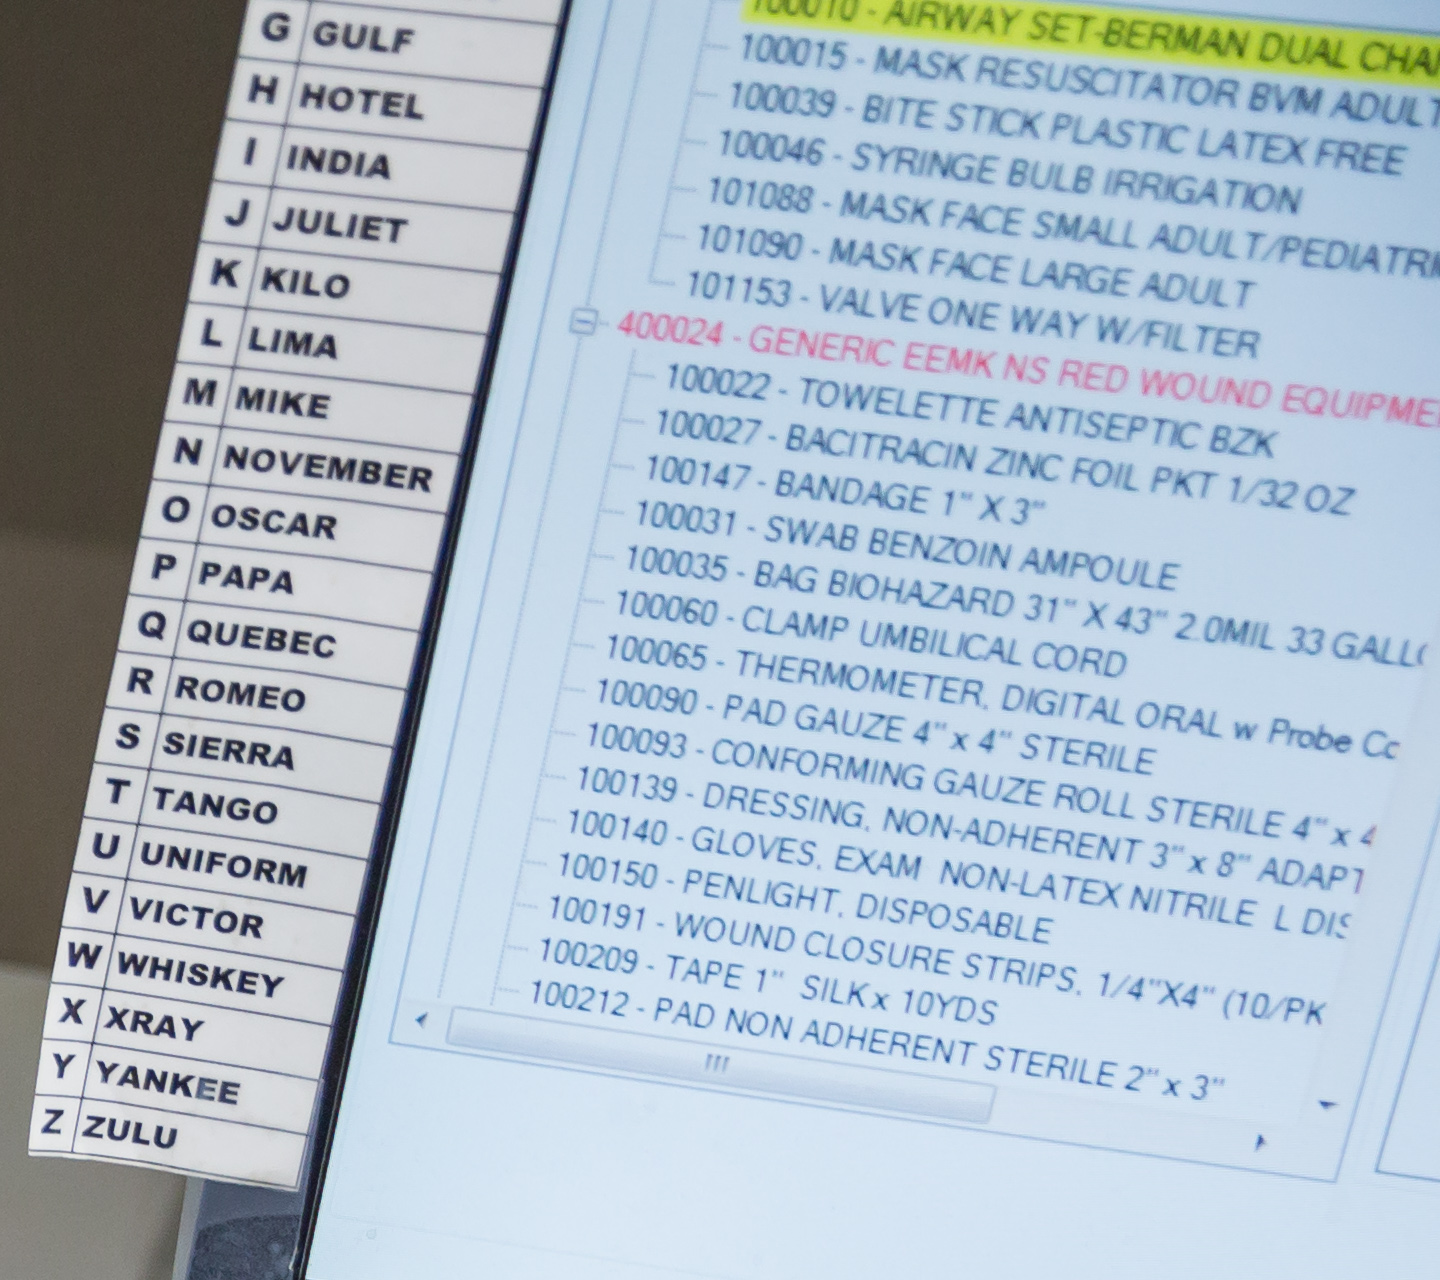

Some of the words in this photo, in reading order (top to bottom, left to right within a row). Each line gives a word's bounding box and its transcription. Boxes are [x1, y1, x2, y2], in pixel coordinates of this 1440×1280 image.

[260, 11, 291, 43] G
[312, 20, 415, 54] GULF
[883, 0, 1020, 37] AIRWAY
[1027, 12, 1249, 60] SET-BERMAN
[1259, 31, 1349, 70] DUAL
[247, 73, 279, 105] H
[298, 82, 424, 121] HOTEL
[741, 31, 849, 72] 100015
[872, 44, 971, 83] MASK
[973, 53, 1242, 109] RESUSCITATOR
[1245, 79, 1326, 117] BVM
[730, 79, 838, 119] 100039
[860, 91, 939, 130] BITE
[943, 100, 1046, 140] STICK
[1048, 111, 1191, 156] PLASTIC
[1195, 127, 1310, 167] LATEX
[1312, 136, 1410, 178] FREE
[243, 136, 257, 166] I
[286, 144, 390, 180] INDIA
[719, 128, 827, 167] 100046
[849, 140, 1001, 186] SYRINGE
[1004, 156, 1095, 196] BULB
[1101, 167, 1304, 216] IRRIGATION
[223, 198, 250, 227] J
[271, 206, 409, 243] JULIET
[209, 257, 241, 288] K
[259, 266, 350, 299] KILO
[698, 222, 805, 262] 101090
[826, 236, 924, 275] MASK
[927, 246, 1014, 285] FACE
[1017, 256, 1135, 298] LARGE
[1136, 270, 1258, 309] ADULT
[200, 317, 222, 348] L
[247, 325, 337, 360] LIMA
[688, 269, 793, 309] 101153
[819, 282, 923, 324] VALVE
[926, 294, 1002, 332] ONE
[1009, 303, 1090, 340] WAY
[1095, 313, 1262, 360] W/FILTER
[616, 310, 723, 346] 400024
[748, 324, 895, 367] GENERIC
[902, 341, 996, 378] EEMK
[1002, 353, 1050, 384] NS
[1058, 358, 1129, 393] RED
[1140, 368, 1272, 409] WOUND
[182, 377, 218, 407] M
[234, 385, 331, 420] MIKE
[667, 361, 773, 402] 100022
[799, 375, 1000, 428] TOWELETTE
[1002, 400, 1203, 451] ANTISEPTIC
[1206, 423, 1279, 459] BZK
[172, 436, 203, 466] N
[222, 444, 433, 493] NOVEMBER
[161, 494, 191, 523] O
[210, 503, 337, 540] OSCAR
[636, 498, 737, 537] 100031
[762, 513, 860, 553] SWAB
[865, 526, 1013, 571] BENZOIN
[1016, 545, 1182, 592] AMPOULE
[150, 552, 177, 580] P
[197, 560, 293, 595] PAPA
[137, 609, 167, 641] Q
[186, 618, 336, 659] QUEBEC
[616, 588, 720, 628] 100060
[740, 603, 850, 642] CLAMP
[858, 618, 1022, 667] UMBILICAL
[1031, 640, 1129, 679] CORD
[125, 665, 154, 695] R
[173, 674, 306, 713] ROMEO
[114, 722, 141, 750] S
[161, 731, 294, 771] SIERRA
[105, 776, 132, 804] T
[152, 785, 278, 825] TANGO
[91, 831, 121, 860] U
[139, 841, 308, 889] UNIFORM
[82, 885, 110, 914] V
[129, 895, 264, 939] VICTOR
[559, 850, 659, 890] 100150
[854, 891, 1055, 945] DISPOSABLE
[67, 940, 103, 970] W
[117, 950, 285, 998] WHISKEY
[58, 996, 87, 1025] X
[103, 1005, 205, 1042] XRAY
[531, 978, 630, 1018] 100212
[652, 995, 716, 1029] PAD
[723, 1006, 794, 1041] NON
[798, 1018, 979, 1067] ADHERENT
[982, 1044, 1119, 1089] STERILE
[52, 1052, 76, 1079] Y
[95, 1059, 241, 1105] YANKEE
[40, 1107, 65, 1135] Z
[81, 1114, 178, 1149] ZULU
